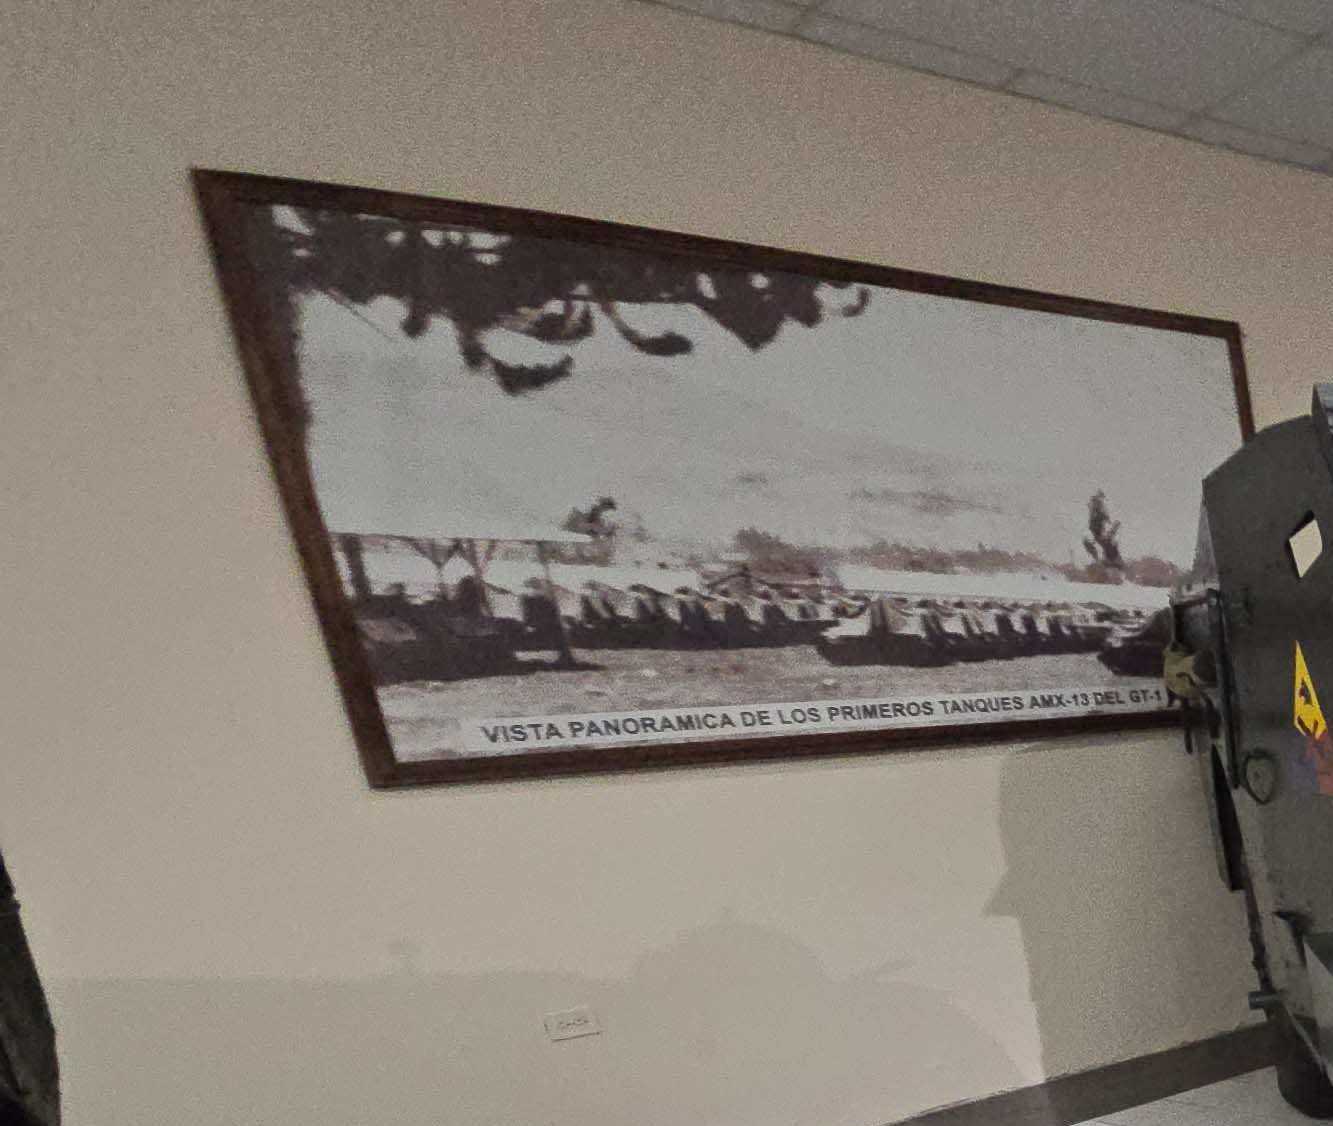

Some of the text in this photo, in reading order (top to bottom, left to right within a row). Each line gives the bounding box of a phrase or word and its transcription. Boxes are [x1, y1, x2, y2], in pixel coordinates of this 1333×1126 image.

[481, 721, 563, 744] VISTA
[568, 711, 737, 738] PANORAMICA
[740, 710, 772, 728] DE
[777, 706, 822, 724] LOS
[828, 699, 934, 722] PRIMEROS
[940, 695, 1027, 715] TANQUES
[1029, 692, 1090, 710] AMX-13
[1093, 690, 1126, 706] DEL
